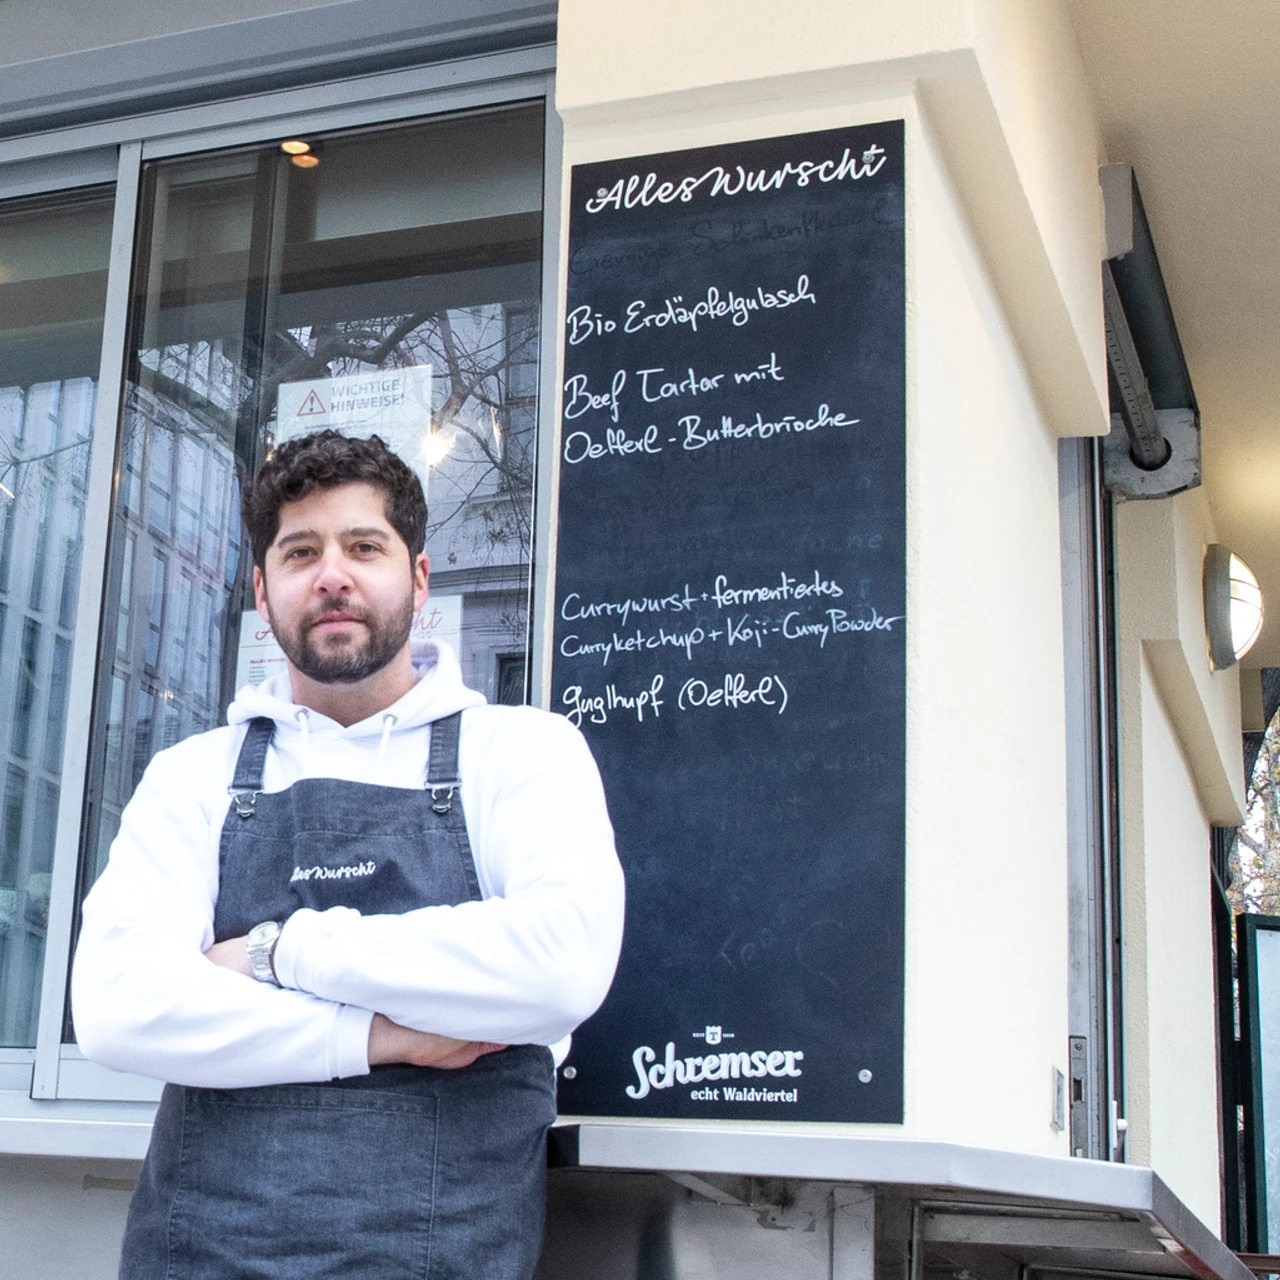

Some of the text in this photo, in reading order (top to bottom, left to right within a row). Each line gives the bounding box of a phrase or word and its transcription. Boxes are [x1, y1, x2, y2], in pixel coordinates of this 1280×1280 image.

[567, 305, 617, 345] Bio
[330, 392, 405, 413] HINWEISE!
[331, 378, 401, 398] WICHTIGE
[564, 352, 785, 422] Beef Tartar mit
[562, 584, 699, 626] Currywurst
[561, 628, 704, 665] Curryketchup
[626, 1042, 804, 1100] Schremser
[690, 1086, 798, 1103] echt Waldviertel
